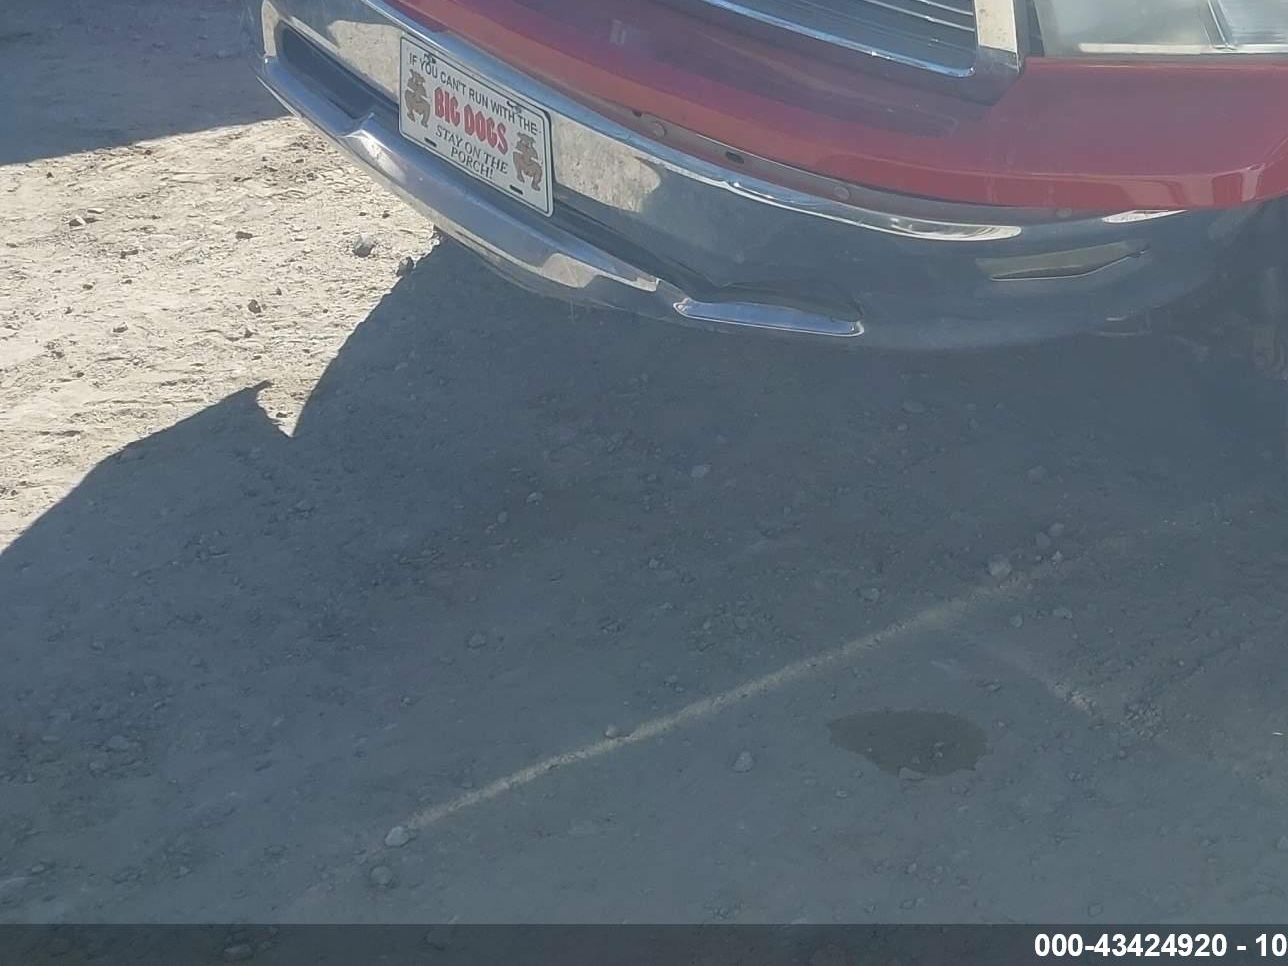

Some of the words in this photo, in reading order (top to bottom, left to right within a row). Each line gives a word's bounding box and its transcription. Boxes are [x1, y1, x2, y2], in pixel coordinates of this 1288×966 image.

[409, 52, 418, 66] IF
[419, 57, 438, 80] YOU
[440, 71, 467, 96] CAN'T
[468, 87, 489, 109] RUN
[490, 100, 516, 123] WITH
[518, 114, 539, 136] THE
[433, 86, 461, 127] BIG
[463, 103, 509, 156] DOGS
[435, 124, 464, 148] STAY
[464, 141, 482, 160] ON
[484, 151, 509, 175] THE
[450, 146, 495, 180] PORCH!
